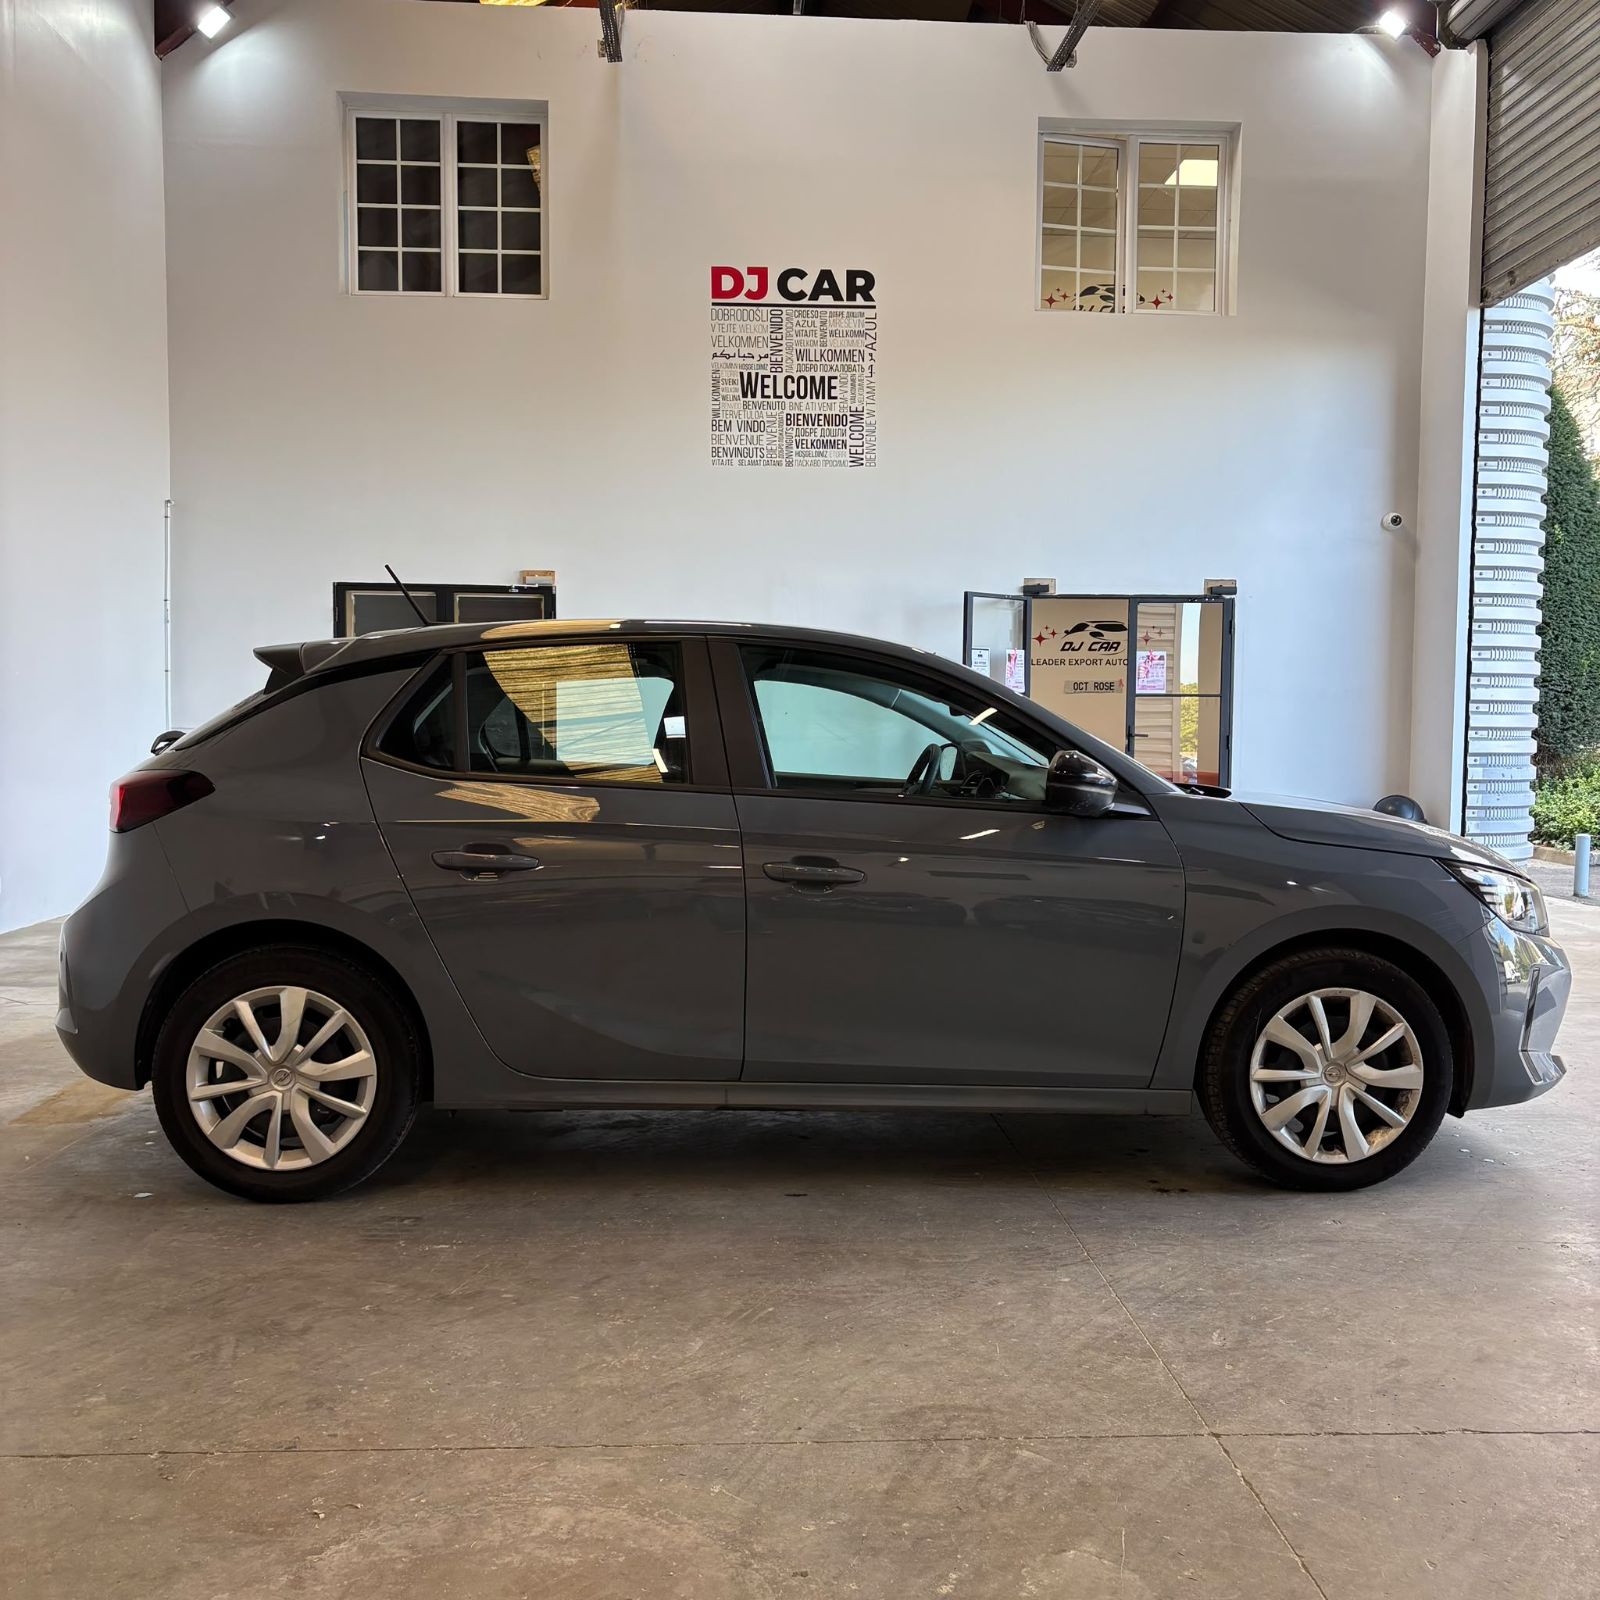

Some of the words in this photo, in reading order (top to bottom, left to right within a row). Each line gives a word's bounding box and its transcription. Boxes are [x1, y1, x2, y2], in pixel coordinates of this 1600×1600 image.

[711, 266, 768, 301] DJ
[777, 267, 876, 302] CAR
[795, 320, 818, 328] AZUL
[864, 312, 877, 351] AZUL
[711, 335, 769, 348] VELKOMMEN
[769, 309, 784, 374] BIENVENIDO
[795, 348, 865, 363] WILLKOMMEN
[796, 363, 818, 373] ДОБРО
[820, 363, 865, 373] ПОЖАЛОВАТЬ
[739, 371, 838, 400] WELCOME
[711, 369, 721, 419] WILLKOMMEN
[865, 379, 876, 407] TAMY
[742, 400, 787, 411] BENVENUTO
[711, 419, 732, 432] BEM
[736, 419, 766, 433] VINDO
[785, 413, 848, 427] BIENVENIDO
[711, 433, 765, 446] BIENVENUE
[765, 411, 778, 459] BIENVENUE
[795, 428, 818, 438] ДОБРЕ
[820, 428, 847, 438] ДОШЛИ
[849, 405, 865, 468] WELCOME
[795, 438, 847, 450] VELKOMMEN
[865, 420, 876, 468] BIENVENUE
[711, 446, 765, 459] BENVINGUTS
[711, 459, 734, 467] VITAJTE
[1060, 641, 1085, 652] DJ
[1088, 641, 1122, 652] CAR
[1031, 658, 1066, 666] LEADER
[1068, 658, 1103, 666] EXPORT
[1073, 681, 1089, 691] OCT
[1093, 681, 1115, 691] ROSE
